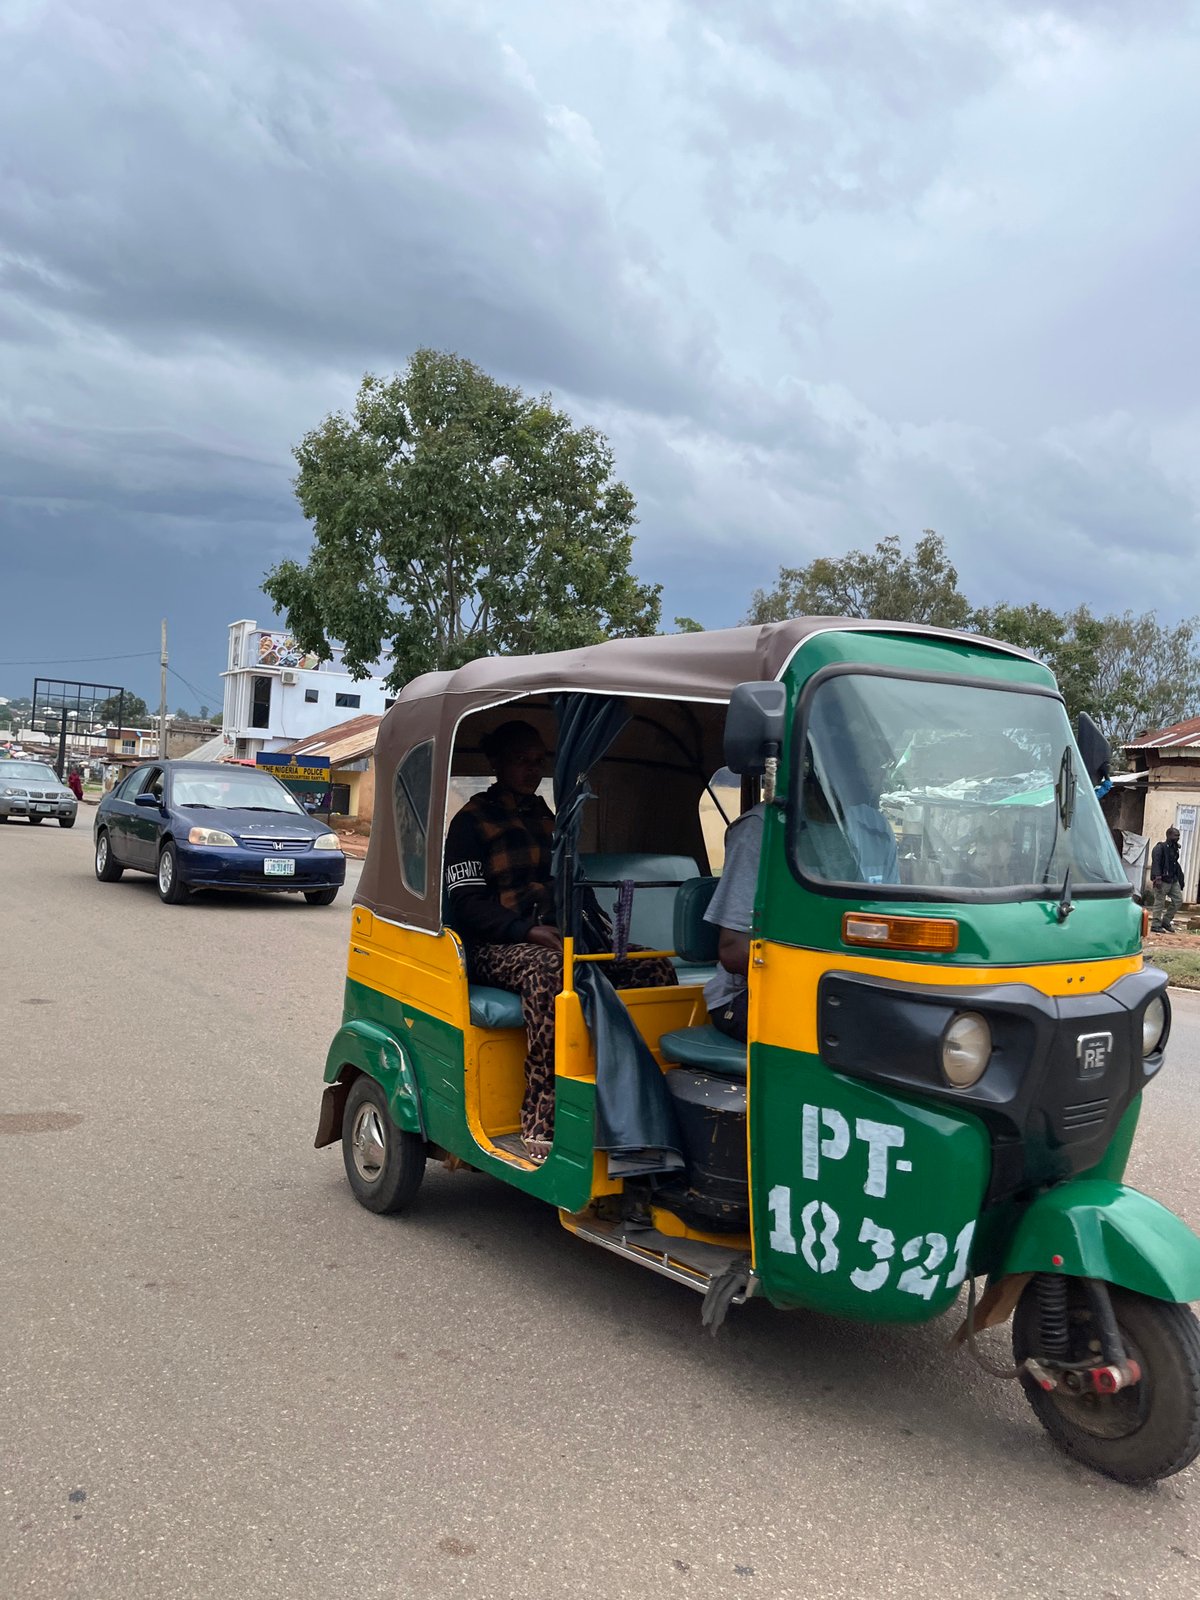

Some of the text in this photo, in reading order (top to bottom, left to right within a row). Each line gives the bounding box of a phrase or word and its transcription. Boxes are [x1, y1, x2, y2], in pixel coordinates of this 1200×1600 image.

[262, 765, 274, 773] THE
[275, 766, 299, 774] NIGERIA
[1084, 1047, 1105, 1069] RE
[802, 1103, 912, 1198] PT-
[768, 1184, 976, 1300] 18321
